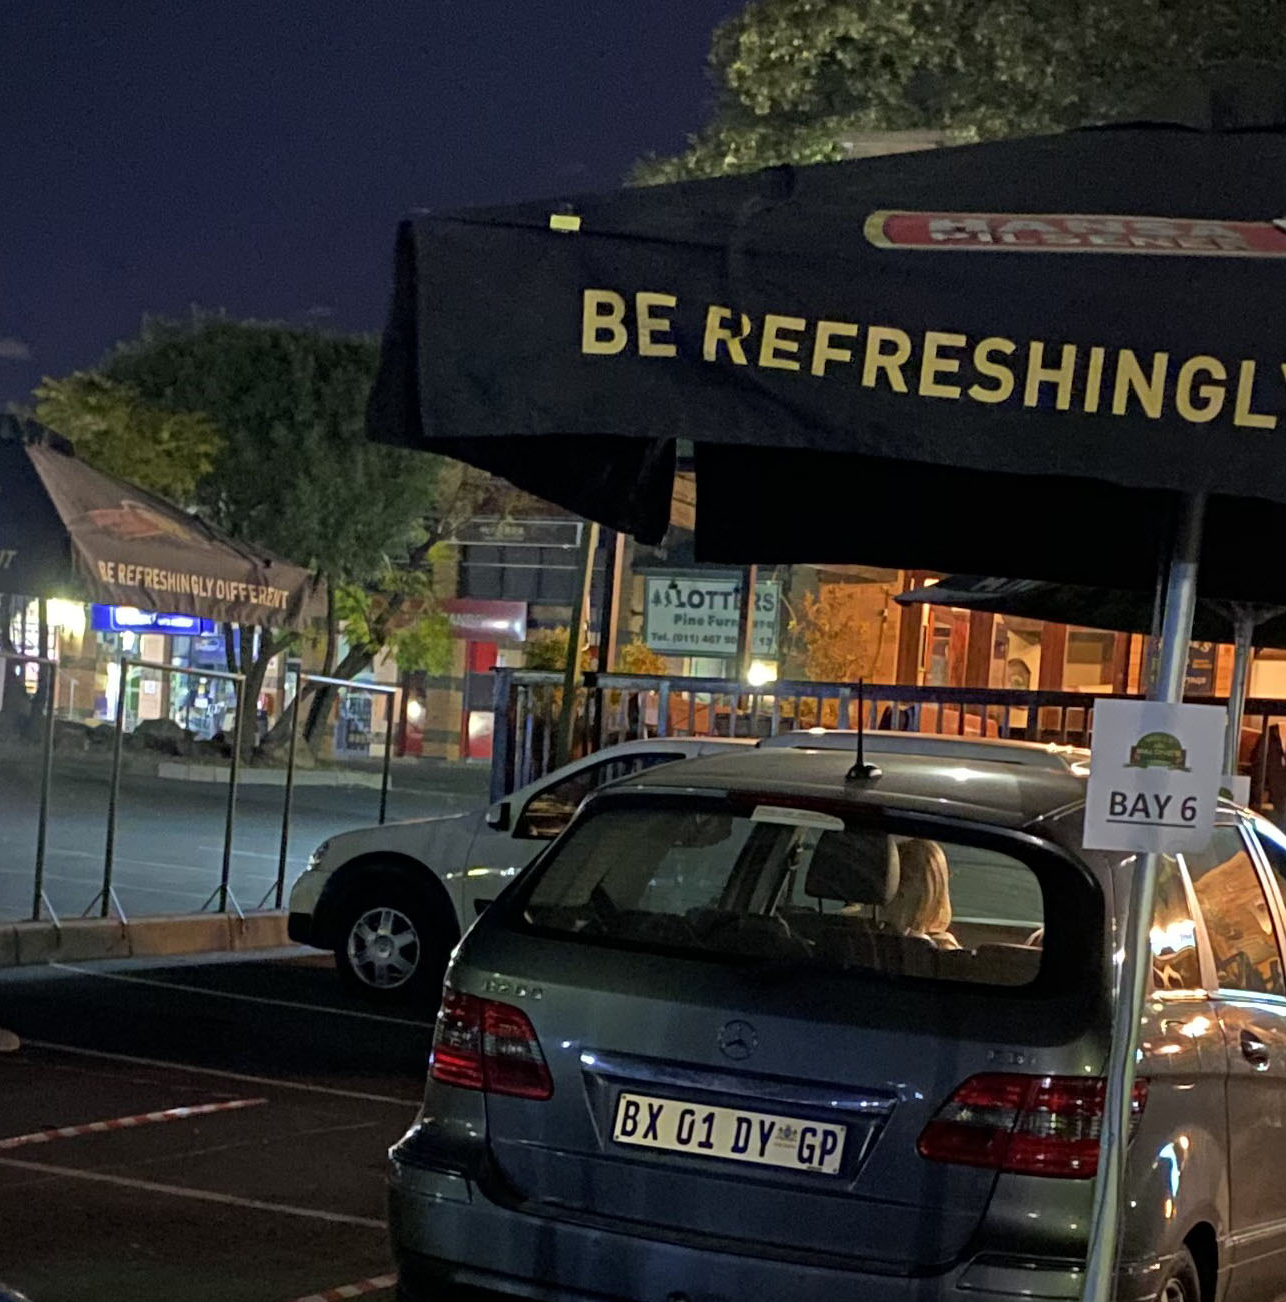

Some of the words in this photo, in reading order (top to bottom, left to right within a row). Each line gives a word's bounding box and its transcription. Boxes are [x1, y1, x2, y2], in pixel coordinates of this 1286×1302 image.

[581, 288, 678, 358] BE
[98, 560, 115, 583] BE
[118, 562, 215, 599] REFRESHINGLY
[216, 580, 290, 610] DIFFERENT
[674, 589, 775, 612] LOTTRS
[674, 612, 706, 627] Pine
[1108, 791, 1173, 820] BAY
[1180, 796, 1198, 822] 6
[620, 1099, 664, 1142] BX
[676, 1108, 716, 1149] 01
[731, 1116, 776, 1158] DY
[797, 1126, 839, 1167] GP
